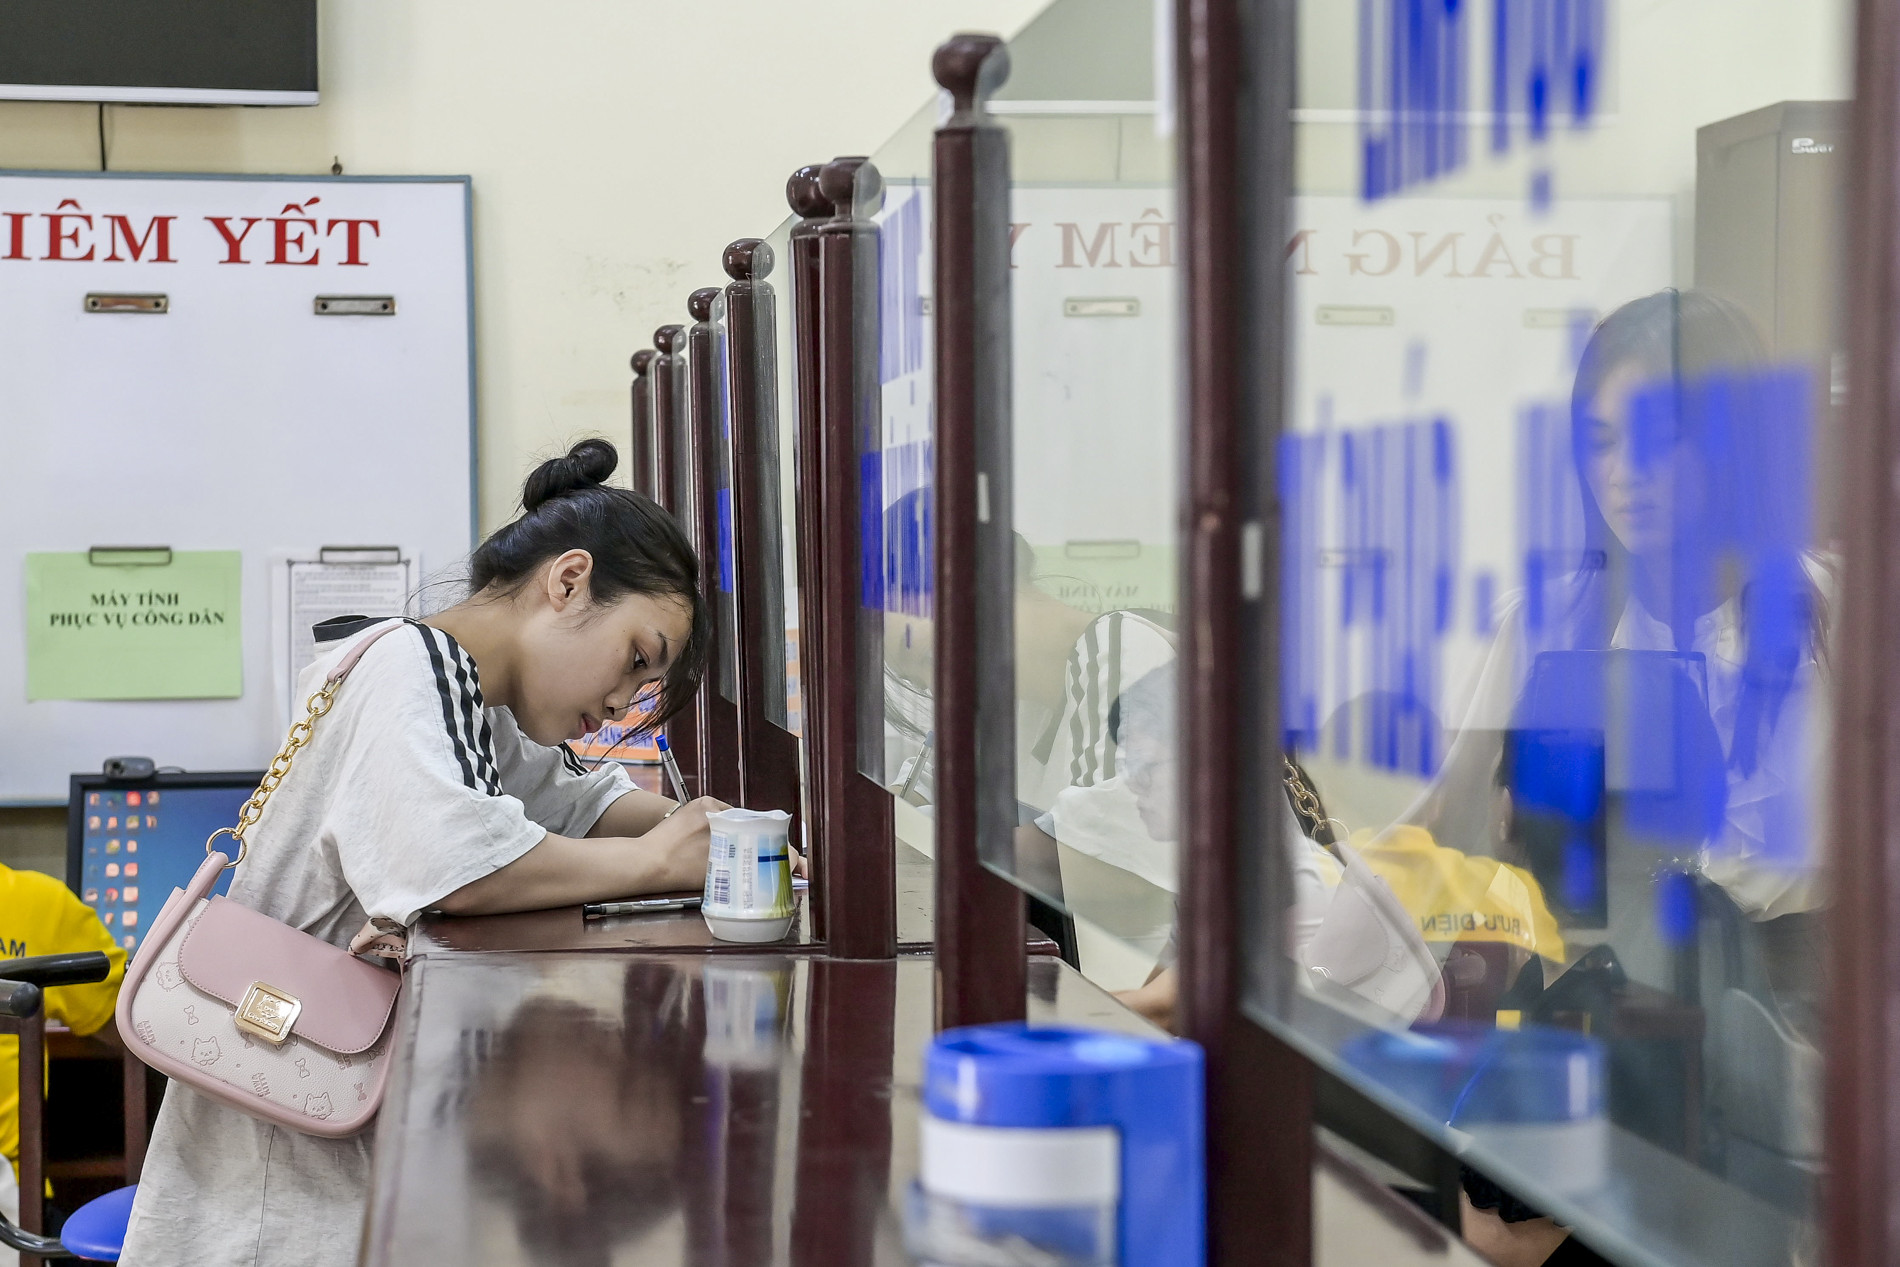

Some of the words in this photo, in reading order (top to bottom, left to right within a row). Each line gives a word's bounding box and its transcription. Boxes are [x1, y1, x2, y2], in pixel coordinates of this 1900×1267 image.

[1, 198, 179, 263] IÊM
[203, 196, 381, 266] YẾT
[91, 590, 131, 606] MÁY
[137, 588, 179, 606] TÍNH
[50, 612, 97, 630] PHỤC
[103, 612, 128, 630] VỤ
[132, 609, 183, 626] CÔNG
[188, 608, 225, 625] DÂN
